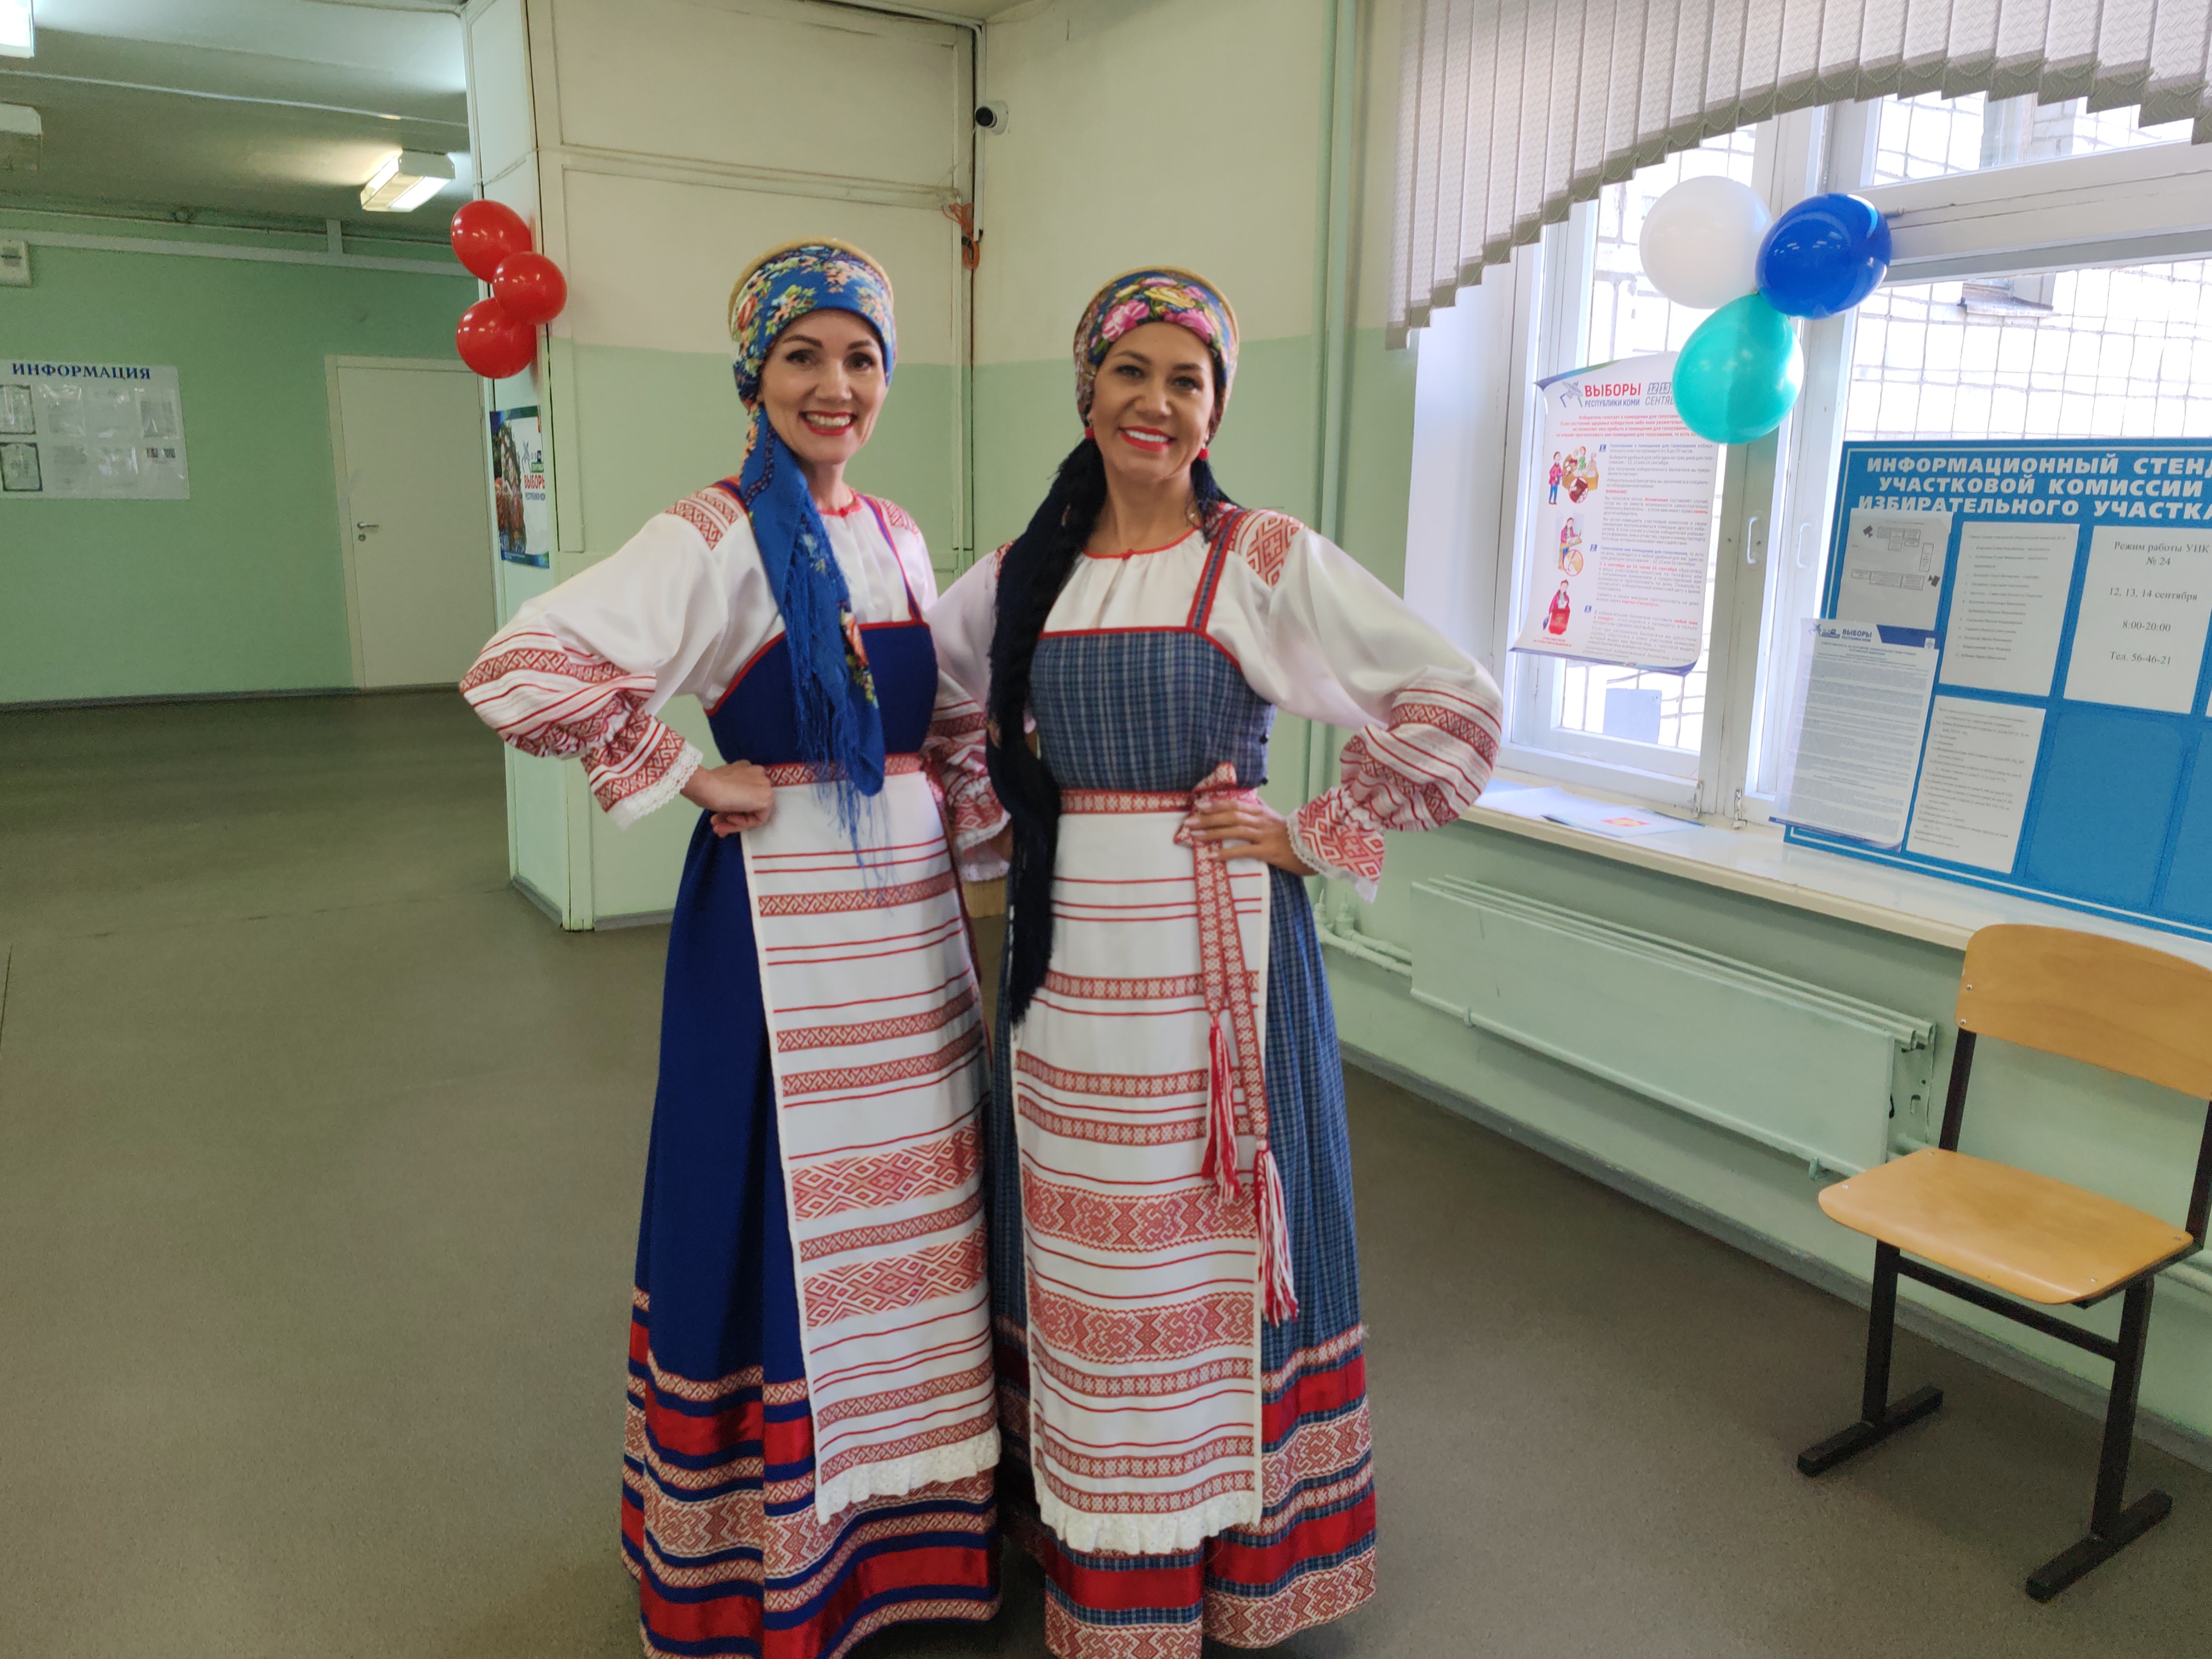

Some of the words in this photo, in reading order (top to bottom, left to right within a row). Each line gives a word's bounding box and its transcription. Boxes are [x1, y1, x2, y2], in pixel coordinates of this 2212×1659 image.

[13, 363, 150, 379] ИНФОРМАЦИЯ
[1584, 383, 1642, 397] ВЫБОРЫ
[1649, 383, 1658, 394] 12
[1661, 383, 1670, 394] 13
[1867, 453, 2119, 476] ИНФОРМАЦИОННЫЙ
[1879, 474, 2035, 494] УЧАСТКОВОЙ
[2048, 478, 2203, 498] КОМИССИИ
[1859, 495, 2079, 516] ИЗБИРАТЕЛЬНОГО
[2114, 541, 2145, 551] Режим
[2147, 543, 2183, 553] работы
[2186, 544, 2210, 554] УИК
[2145, 556, 2157, 566] №
[2159, 557, 2171, 566] 24
[2110, 587, 2122, 598] 12,
[2125, 588, 2138, 598] 13,
[2142, 589, 2152, 598] 14
[2154, 591, 2198, 603] сентября
[2122, 620, 2171, 632] 8:00-20:00
[1842, 629, 1872, 638] ВЫБОРЫ
[2110, 651, 2128, 662] Тел.
[2131, 653, 2171, 665] 56-46-21
